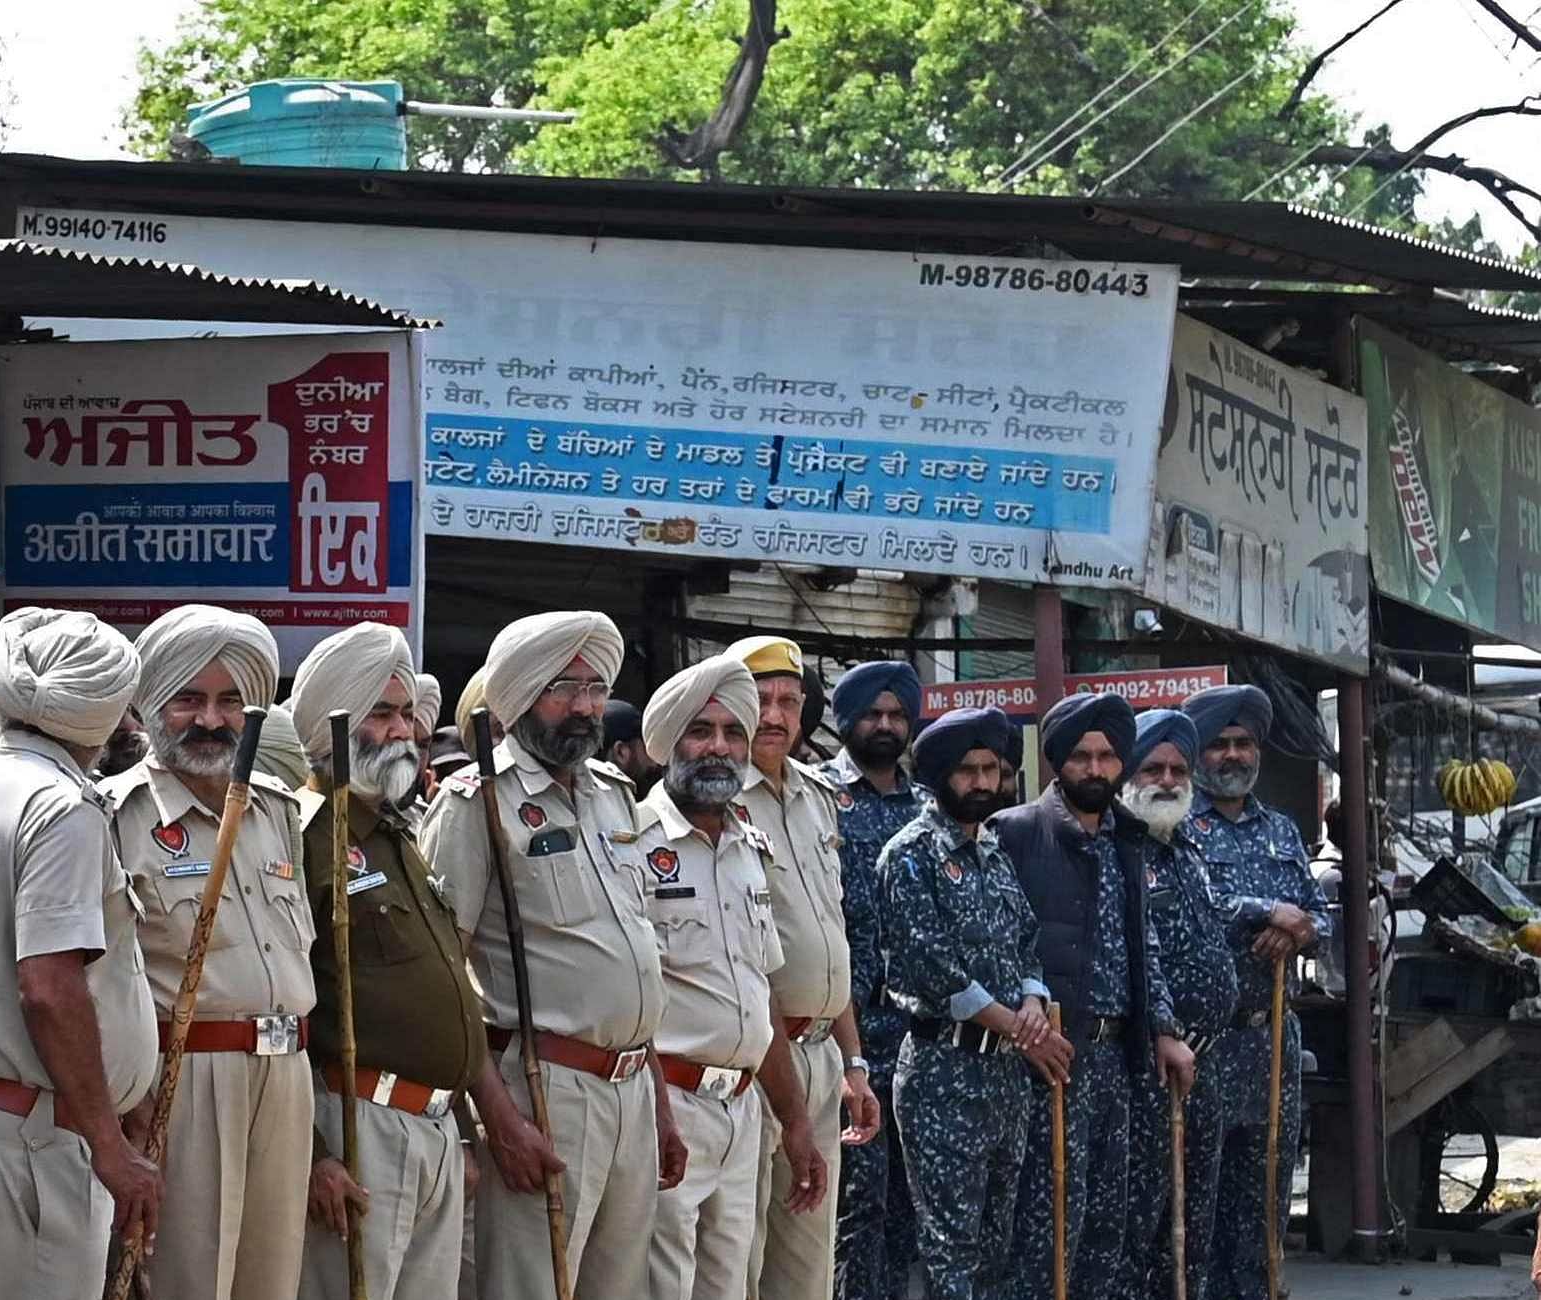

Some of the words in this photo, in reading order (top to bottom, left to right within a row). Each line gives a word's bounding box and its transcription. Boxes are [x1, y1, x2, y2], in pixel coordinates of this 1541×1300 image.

[919, 263, 1150, 296] M-98786-80443
[425, 355, 485, 376] ਾਲਜਾਂ
[498, 357, 557, 382] ਦੀਆਂ
[295, 378, 385, 407] ਦੁਨੀਆ
[23, 400, 261, 467] ਅਜੀਤ
[654, 395, 697, 419] ਅਤੇ
[880, 414, 909, 432] ਦਾ
[920, 415, 990, 439] ਸਮਾਨ
[1005, 418, 1086, 443] ਮਿਲਦਾ
[309, 440, 368, 465] ਨੰਬਰ
[431, 424, 506, 450] ਕਾਲਜਾਂ
[527, 427, 548, 453] ਦੇ
[646, 435, 666, 462] ਦੇ
[676, 441, 744, 466] ਮਾਡਲ
[879, 451, 908, 477] ਵੀ
[920, 455, 989, 483] ਬਣਾਏ
[1510, 421, 1541, 482] KIS
[632, 476, 669, 498] ਹਰ
[735, 479, 756, 505] ਦੇ
[843, 485, 871, 512] ਵੀ
[884, 488, 922, 514] ਭਰੇ
[994, 502, 1034, 523] ਹਨ
[23, 511, 128, 564] अजीत
[131, 521, 277, 564] समाचार
[1108, 562, 1135, 582] Art
[927, 690, 949, 711] M:
[953, 686, 1036, 709] 98786-80
